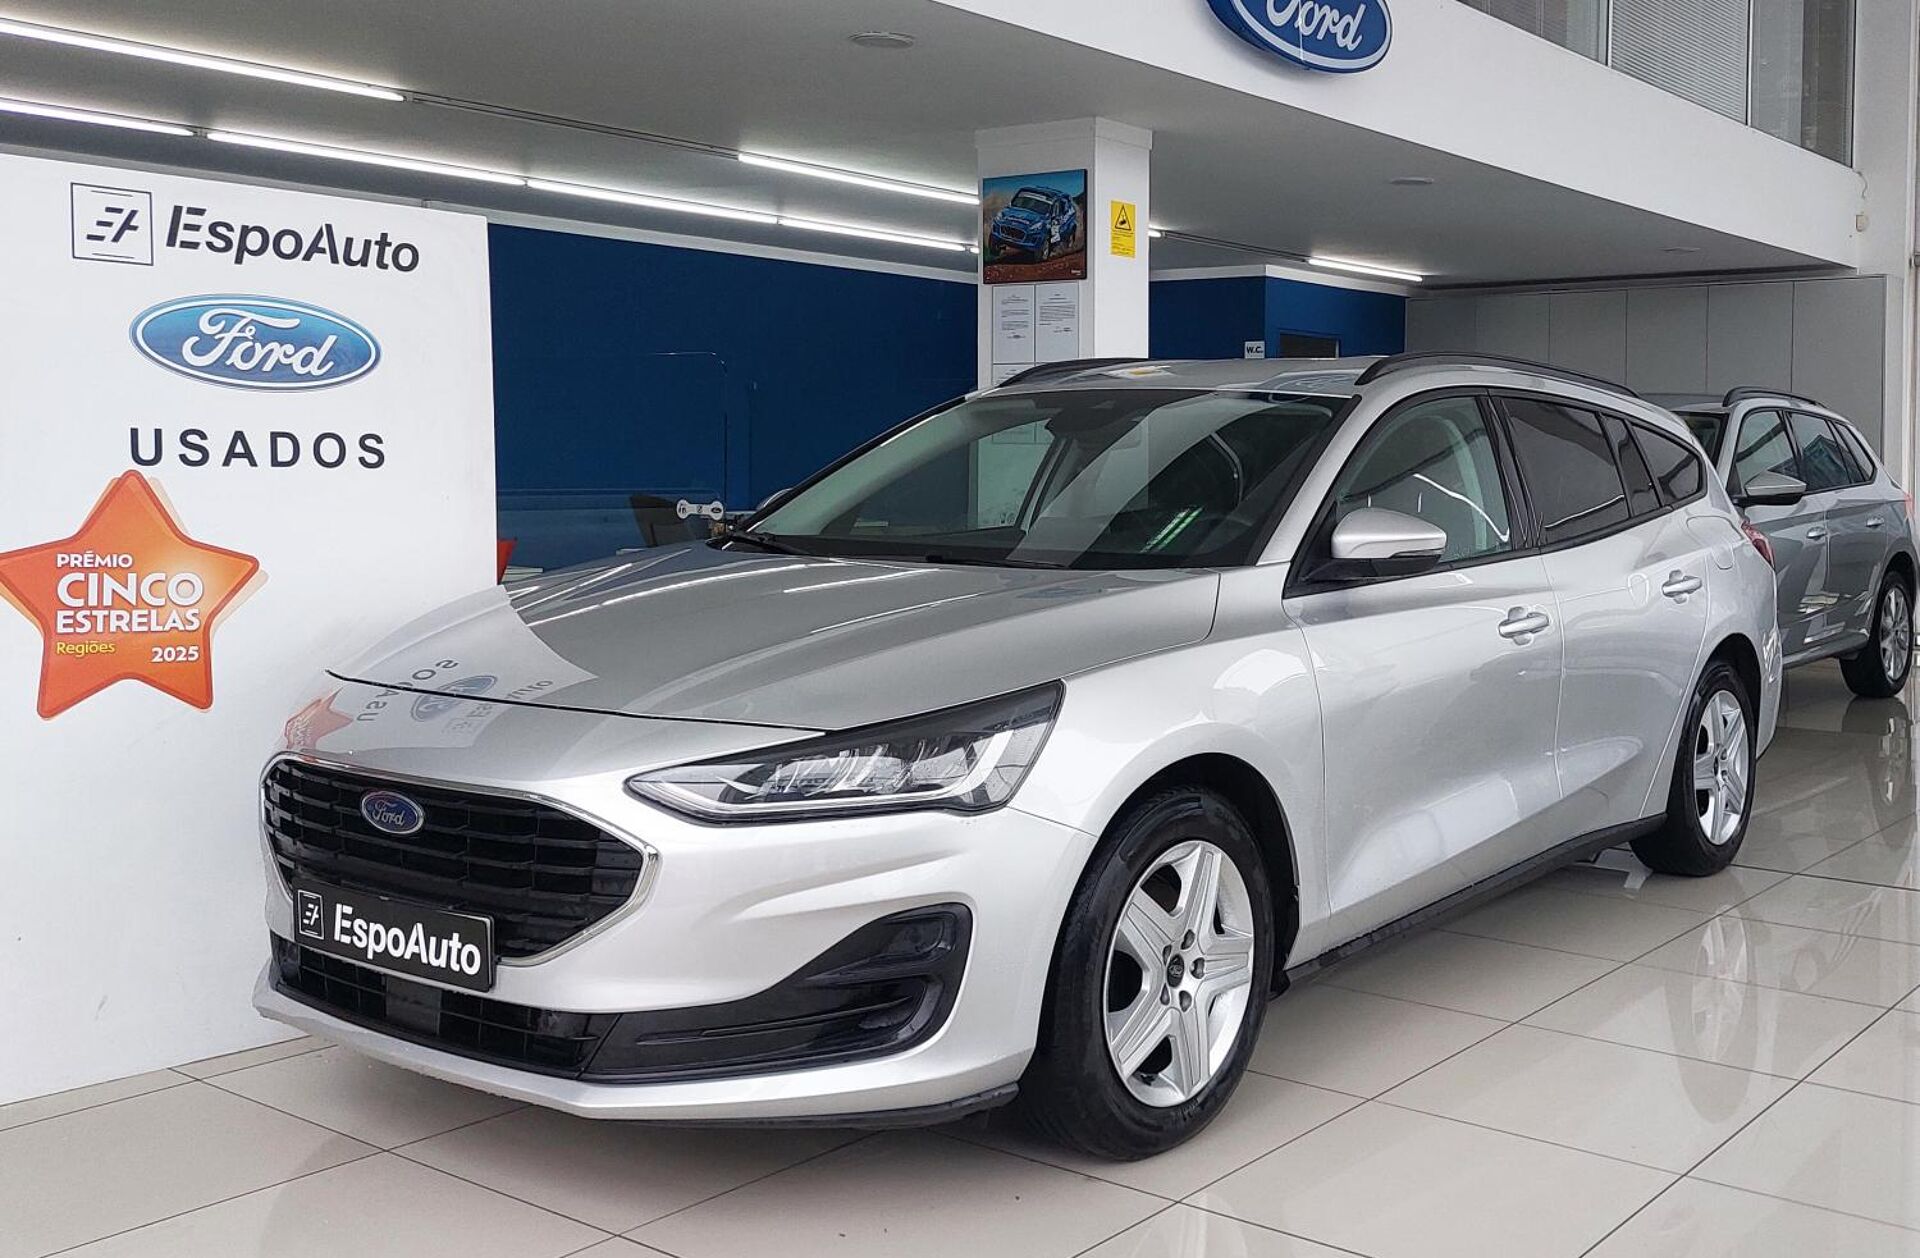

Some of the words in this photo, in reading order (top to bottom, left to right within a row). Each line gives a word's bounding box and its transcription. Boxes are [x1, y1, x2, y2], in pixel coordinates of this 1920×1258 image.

[166, 204, 420, 272] EspoAuto
[181, 307, 338, 377] Ford
[1246, 346, 1263, 354] W.C.
[129, 427, 386, 469] USADOS
[56, 550, 133, 568] PRÉMIO
[57, 572, 204, 608] CINCO
[56, 609, 201, 634] ESTRELAS
[56, 640, 116, 657] Regiões
[151, 645, 200, 662] 2025
[371, 800, 405, 827] Ford
[333, 903, 481, 975] EspoAuto
